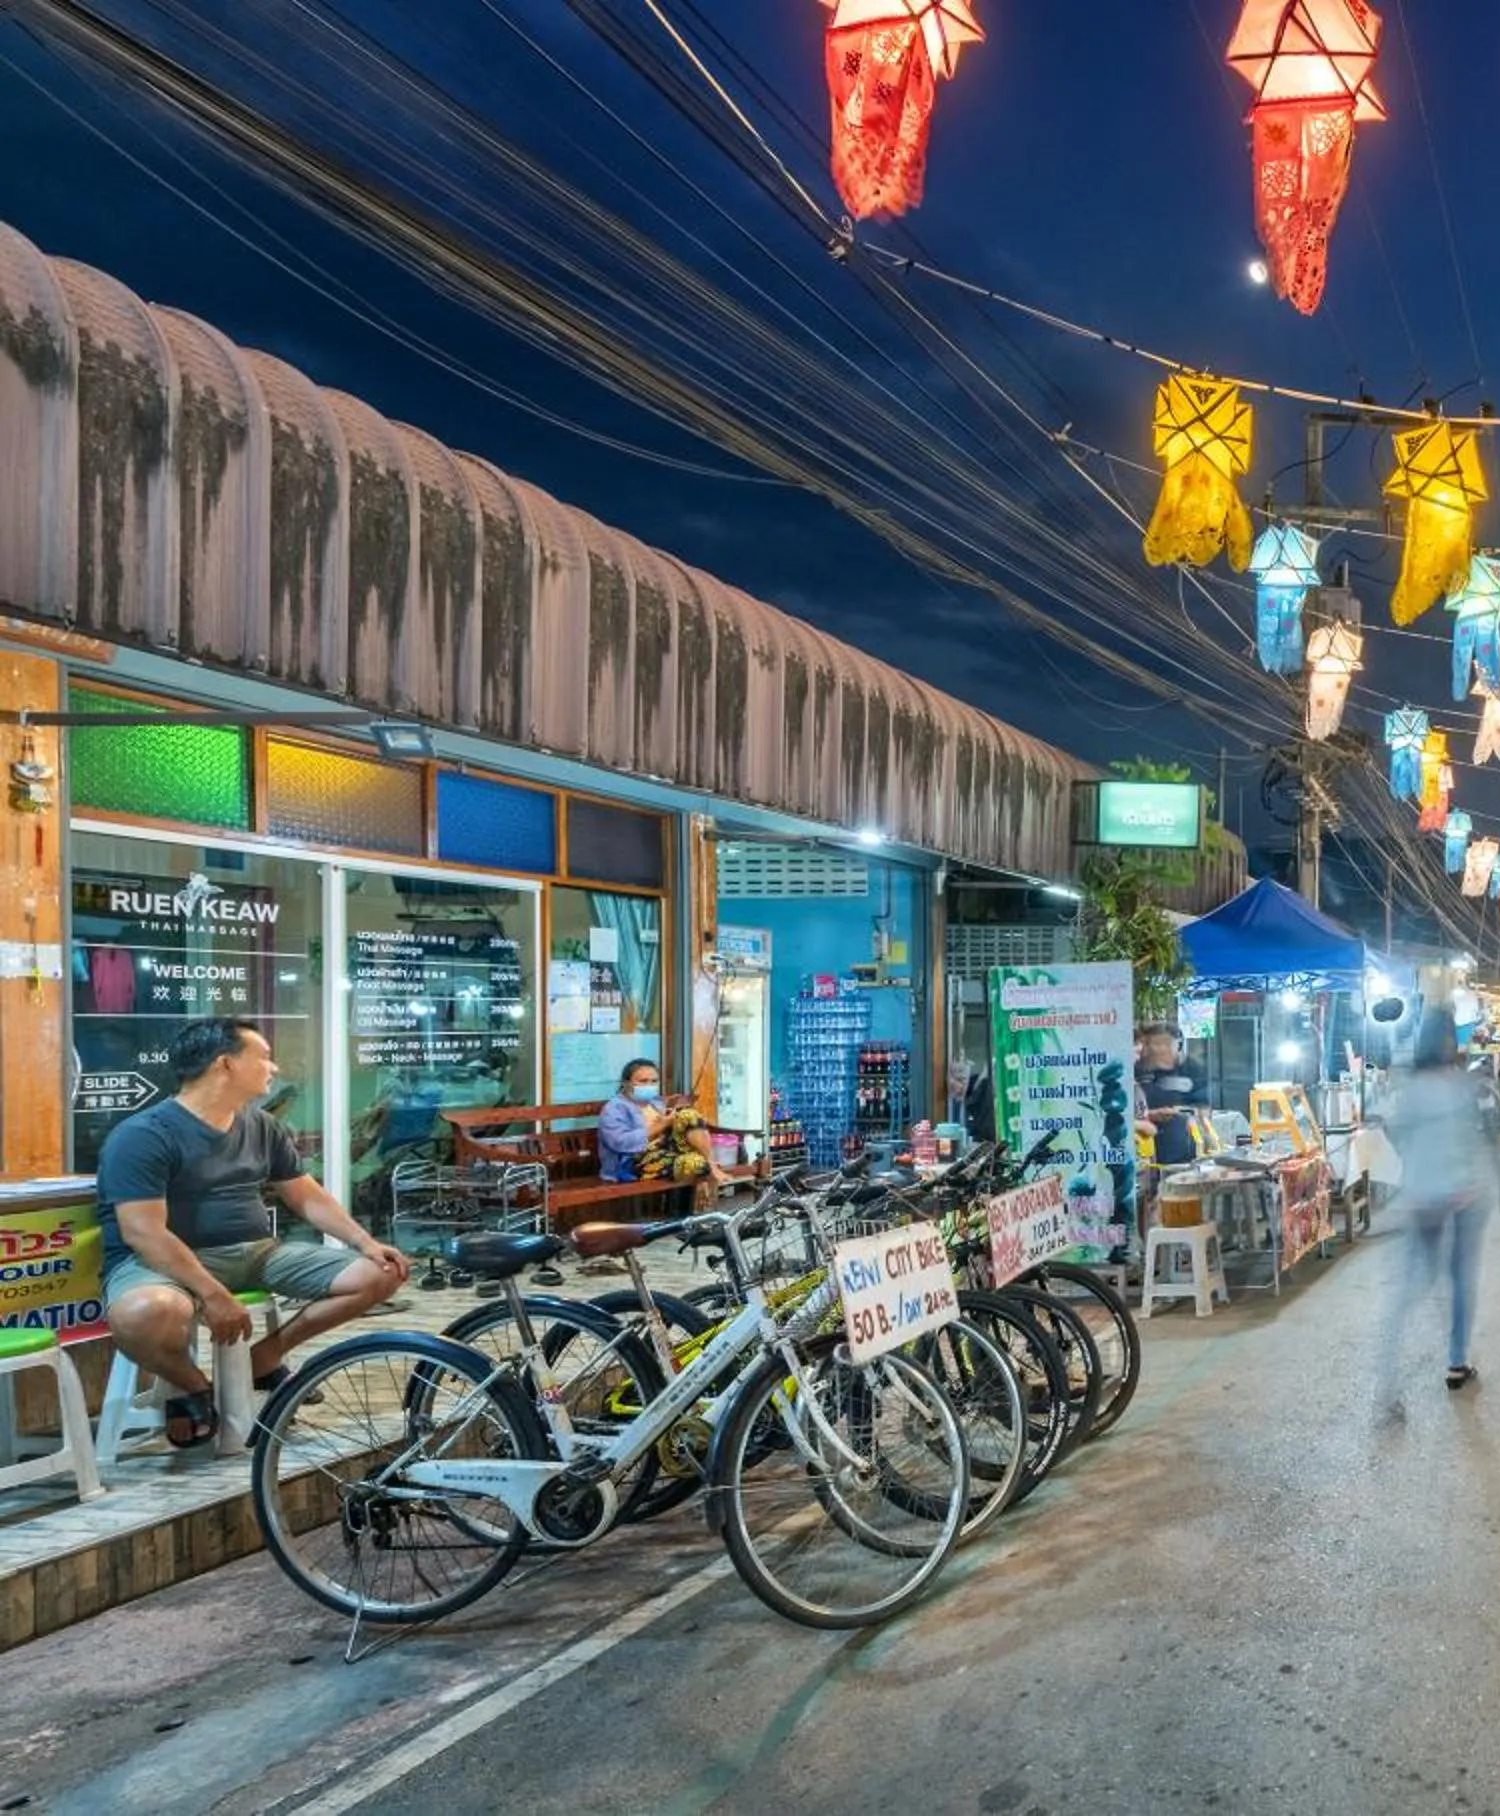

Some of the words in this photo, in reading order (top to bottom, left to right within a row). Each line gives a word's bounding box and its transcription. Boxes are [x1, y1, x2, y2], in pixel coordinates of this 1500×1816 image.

[110, 889, 194, 919] RUEN
[200, 898, 280, 924] KEAW
[140, 920, 180, 932] THAI
[185, 923, 258, 938] MASSAGE
[152, 964, 247, 981] WELCOME
[84, 1076, 130, 1090] SLIDE
[885, 1243, 914, 1280] CITY
[915, 1235, 945, 1270] BIKE
[852, 1308, 875, 1345] 50
